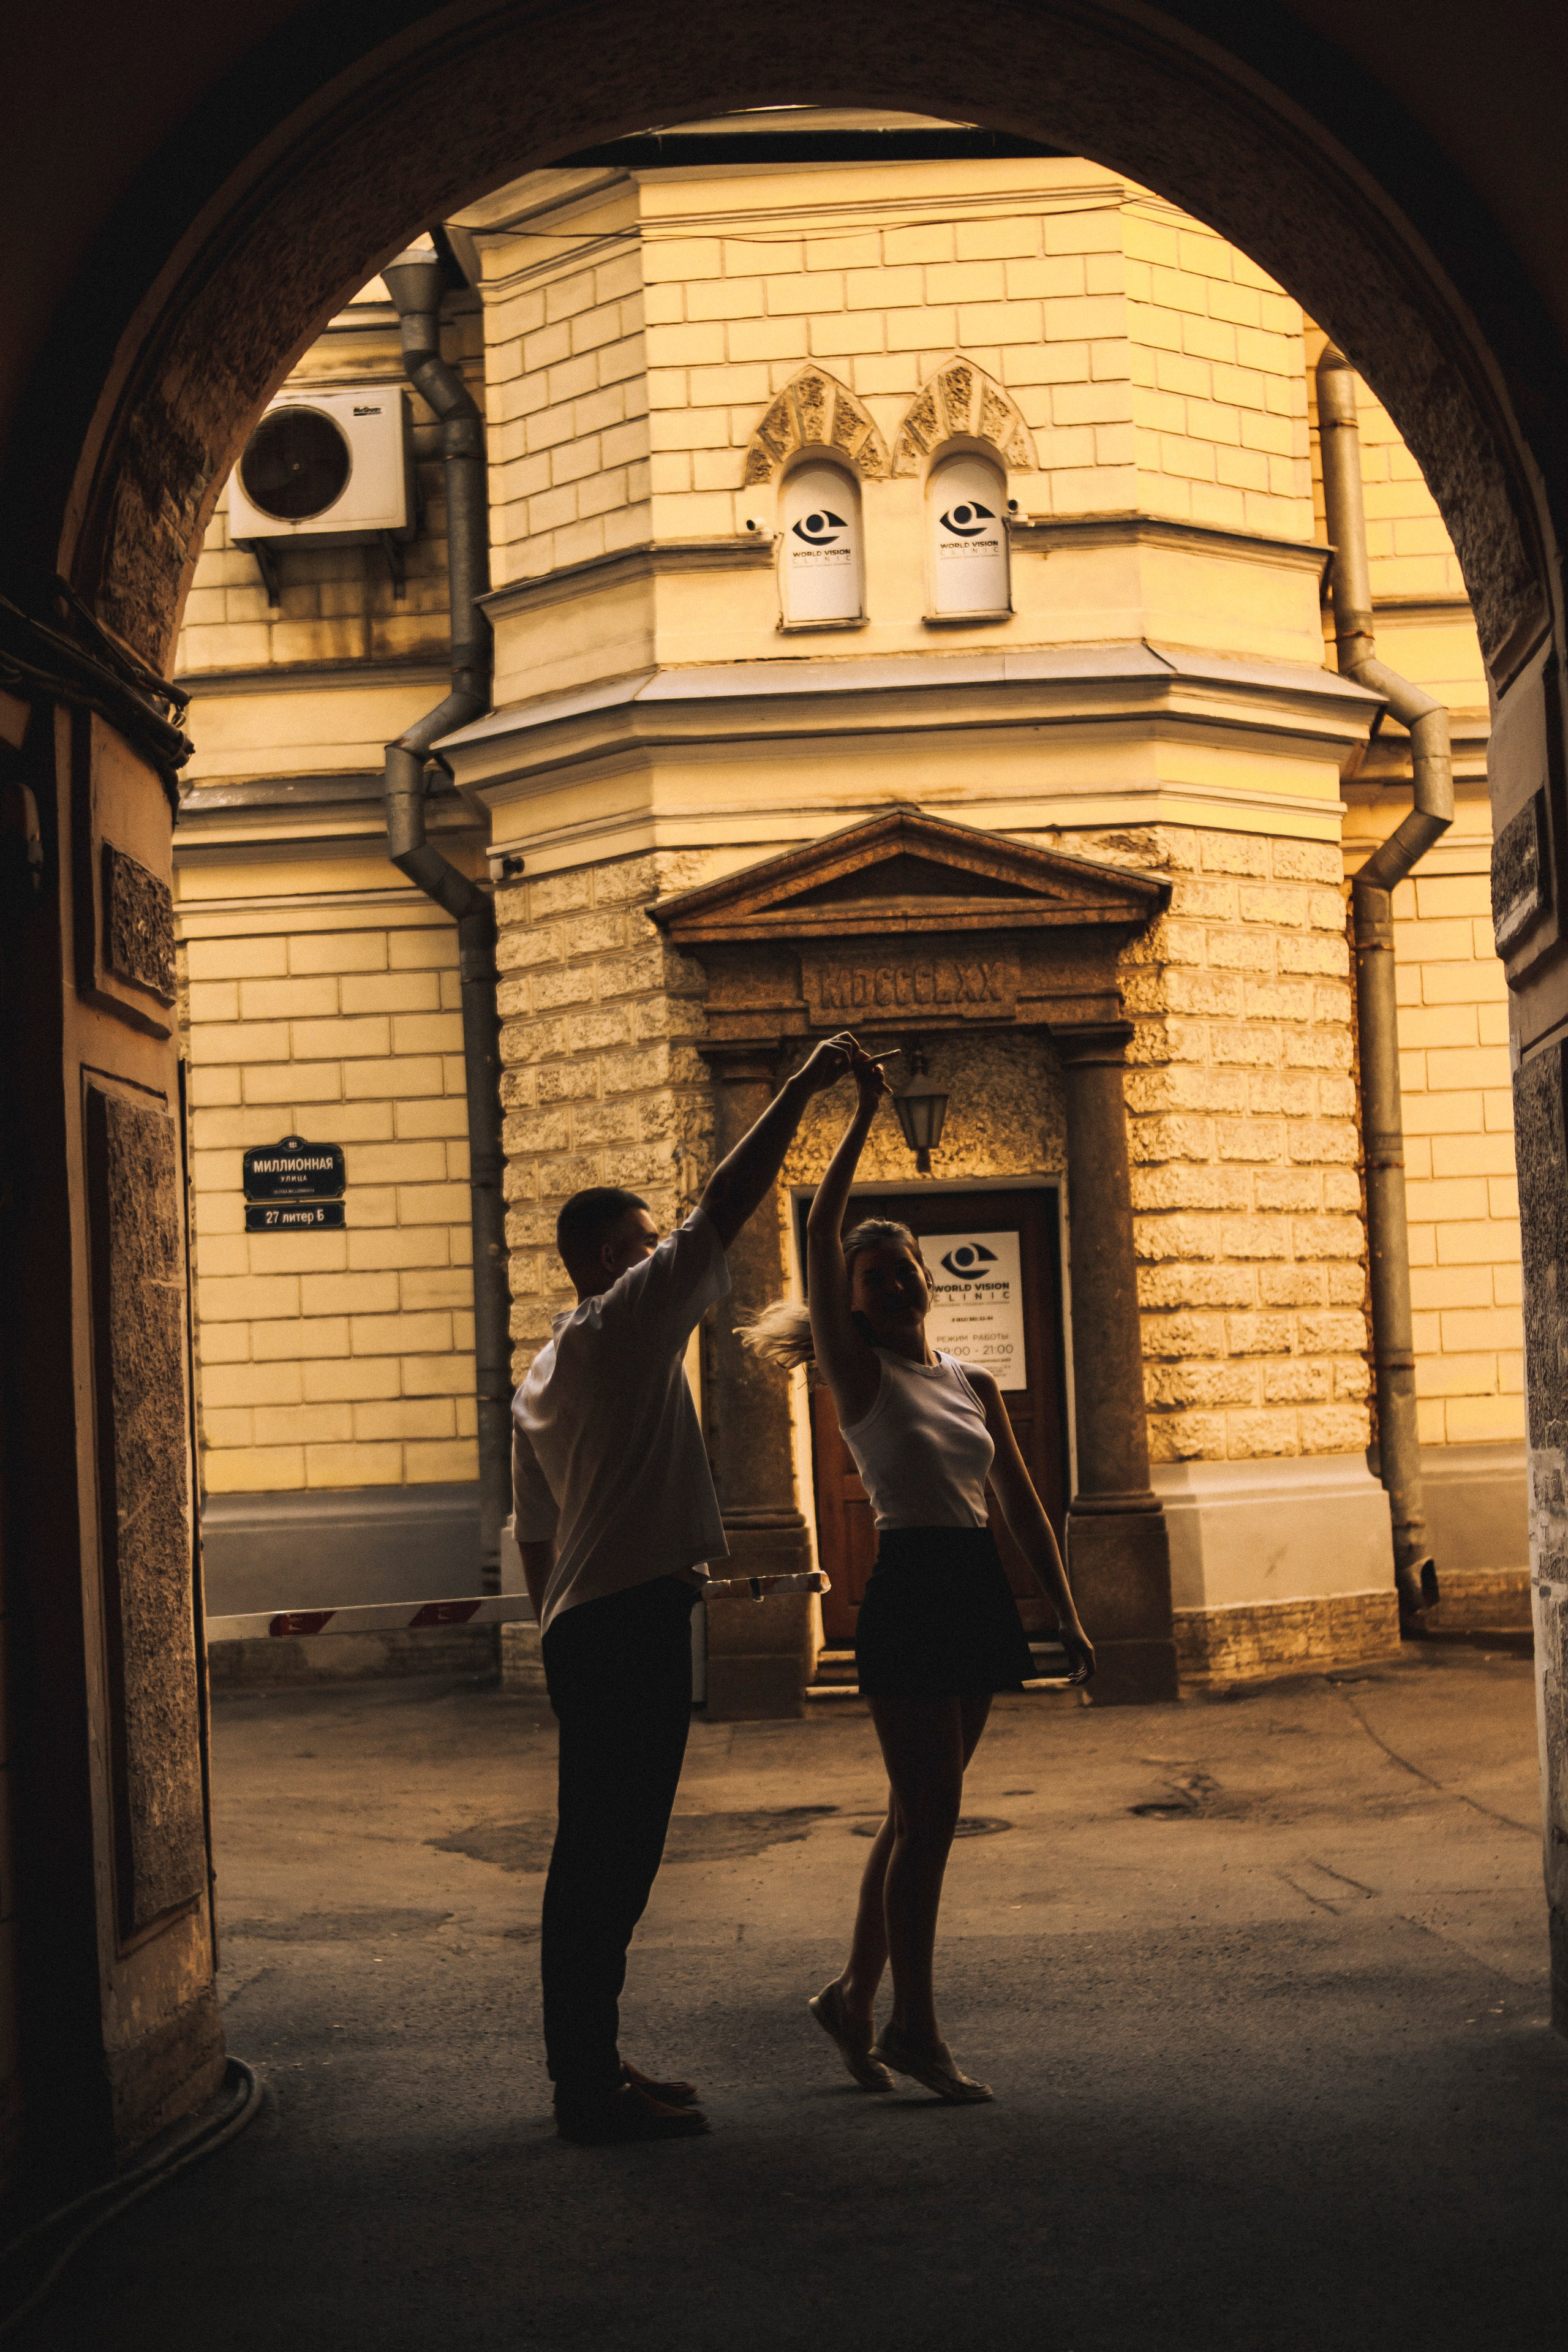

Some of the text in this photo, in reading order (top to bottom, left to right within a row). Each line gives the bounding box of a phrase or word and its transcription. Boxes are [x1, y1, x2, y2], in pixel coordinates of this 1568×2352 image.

[940, 547, 999, 556] CLINIC
[793, 556, 851, 564] CLINIC
[820, 960, 1004, 1009] MDCCCLXX
[254, 1157, 333, 1173] МИЛЛИОННАЯ
[266, 1208, 325, 1225] 27 литер Б
[933, 1282, 1009, 1292] WORLD VISION
[933, 1291, 1010, 1302] CLINIC
[983, 1344, 1014, 1355] 21:00
